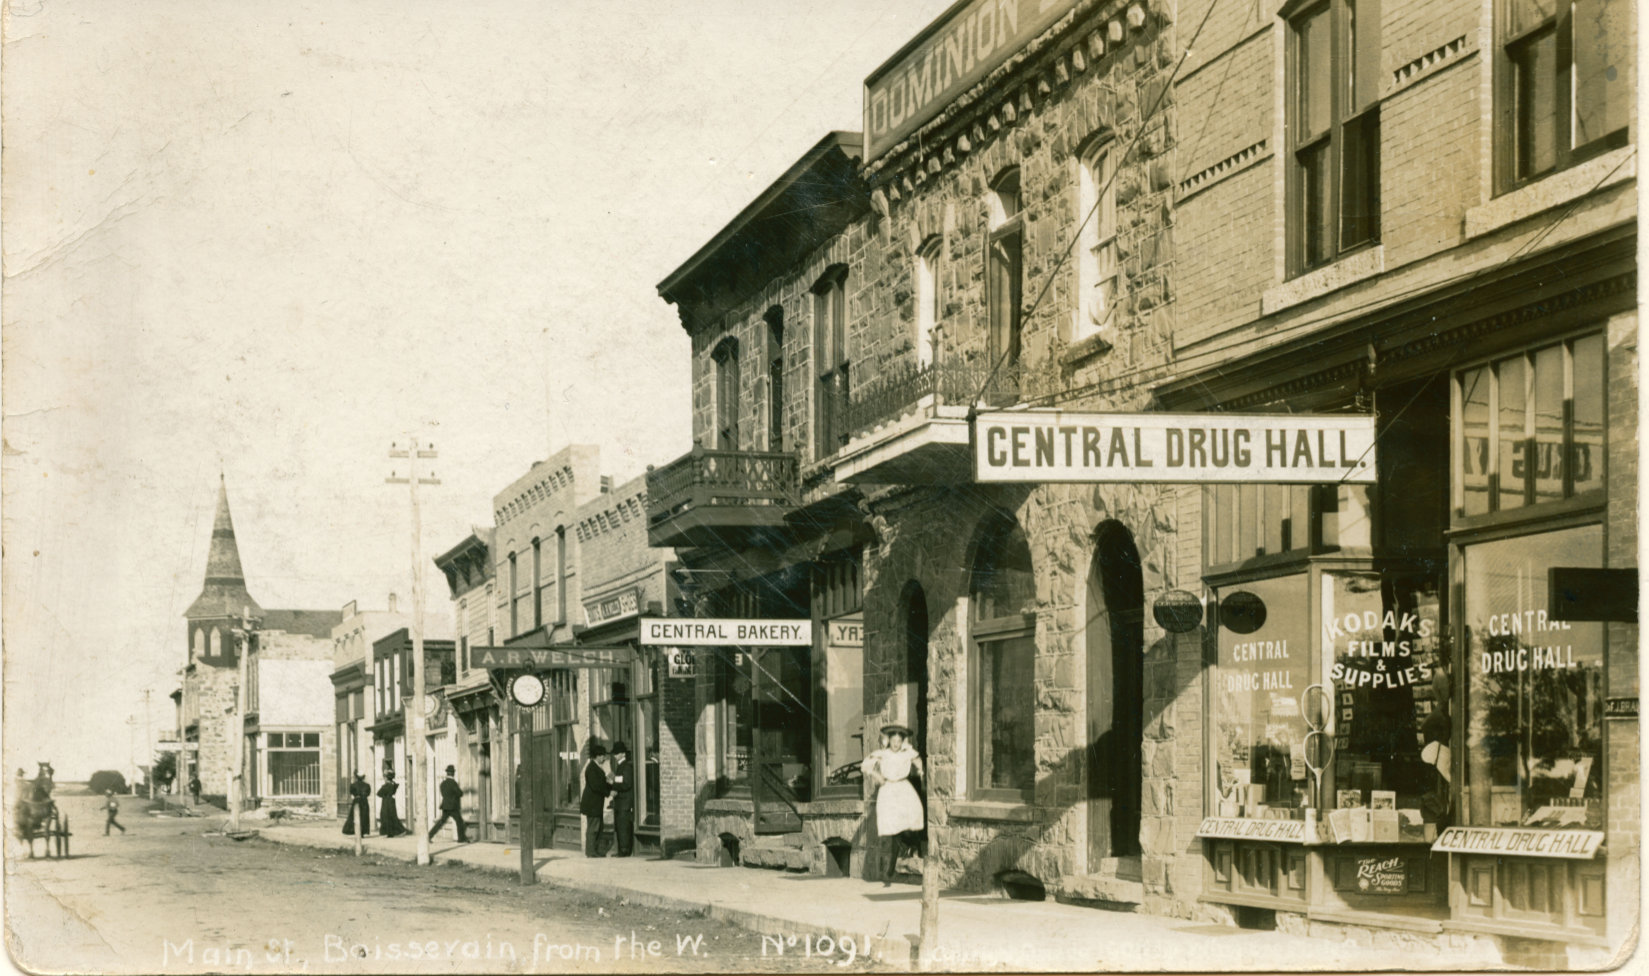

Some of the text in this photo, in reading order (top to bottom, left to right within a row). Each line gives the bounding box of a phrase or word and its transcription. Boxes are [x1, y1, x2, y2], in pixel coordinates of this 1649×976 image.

[872, 0, 1018, 136] DOMINION
[987, 426, 1367, 469] CENTRAL DRUG HALL.
[651, 624, 803, 640] CENTRAL BAKERY.
[1325, 610, 1434, 641] KODAKS
[1233, 639, 1289, 662] CENTRAL
[1348, 640, 1411, 657] FILMS
[1481, 645, 1577, 674] DRUG HALL
[1329, 662, 1432, 689] SUPPLIES
[1376, 658, 1387, 672] &
[1227, 670, 1294, 693] DRUG HALL
[1199, 819, 1305, 839] CENTRAL DRUG HALL
[1440, 829, 1592, 854] CENTRAL DRUG HALL
[1357, 857, 1399, 878] REACH
